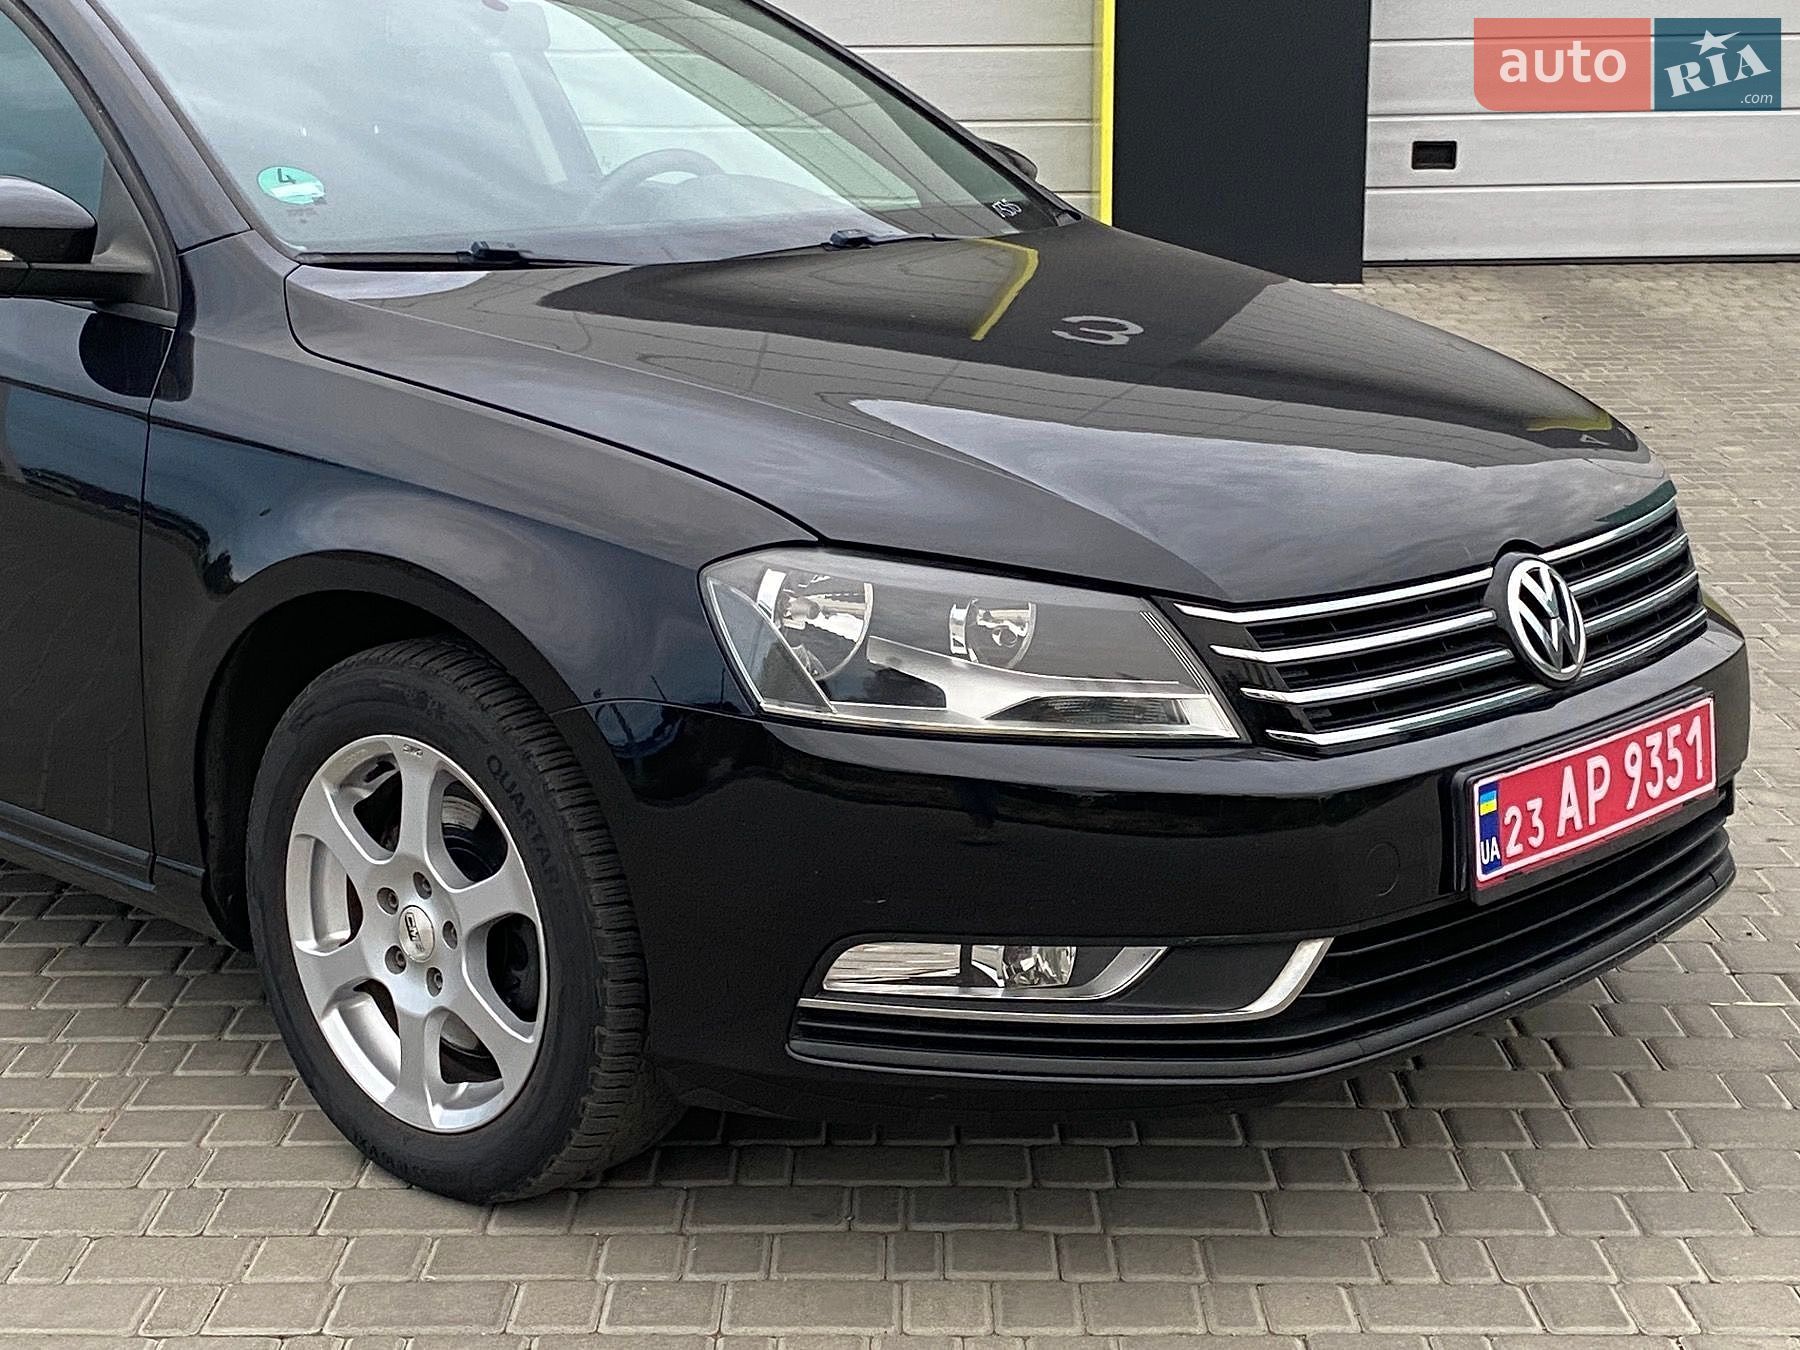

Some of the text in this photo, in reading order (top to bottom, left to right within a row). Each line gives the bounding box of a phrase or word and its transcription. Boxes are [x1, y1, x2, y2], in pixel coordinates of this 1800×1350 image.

[1503, 714, 1704, 858] 23 AP 9351
[1480, 840, 1501, 866] UA
